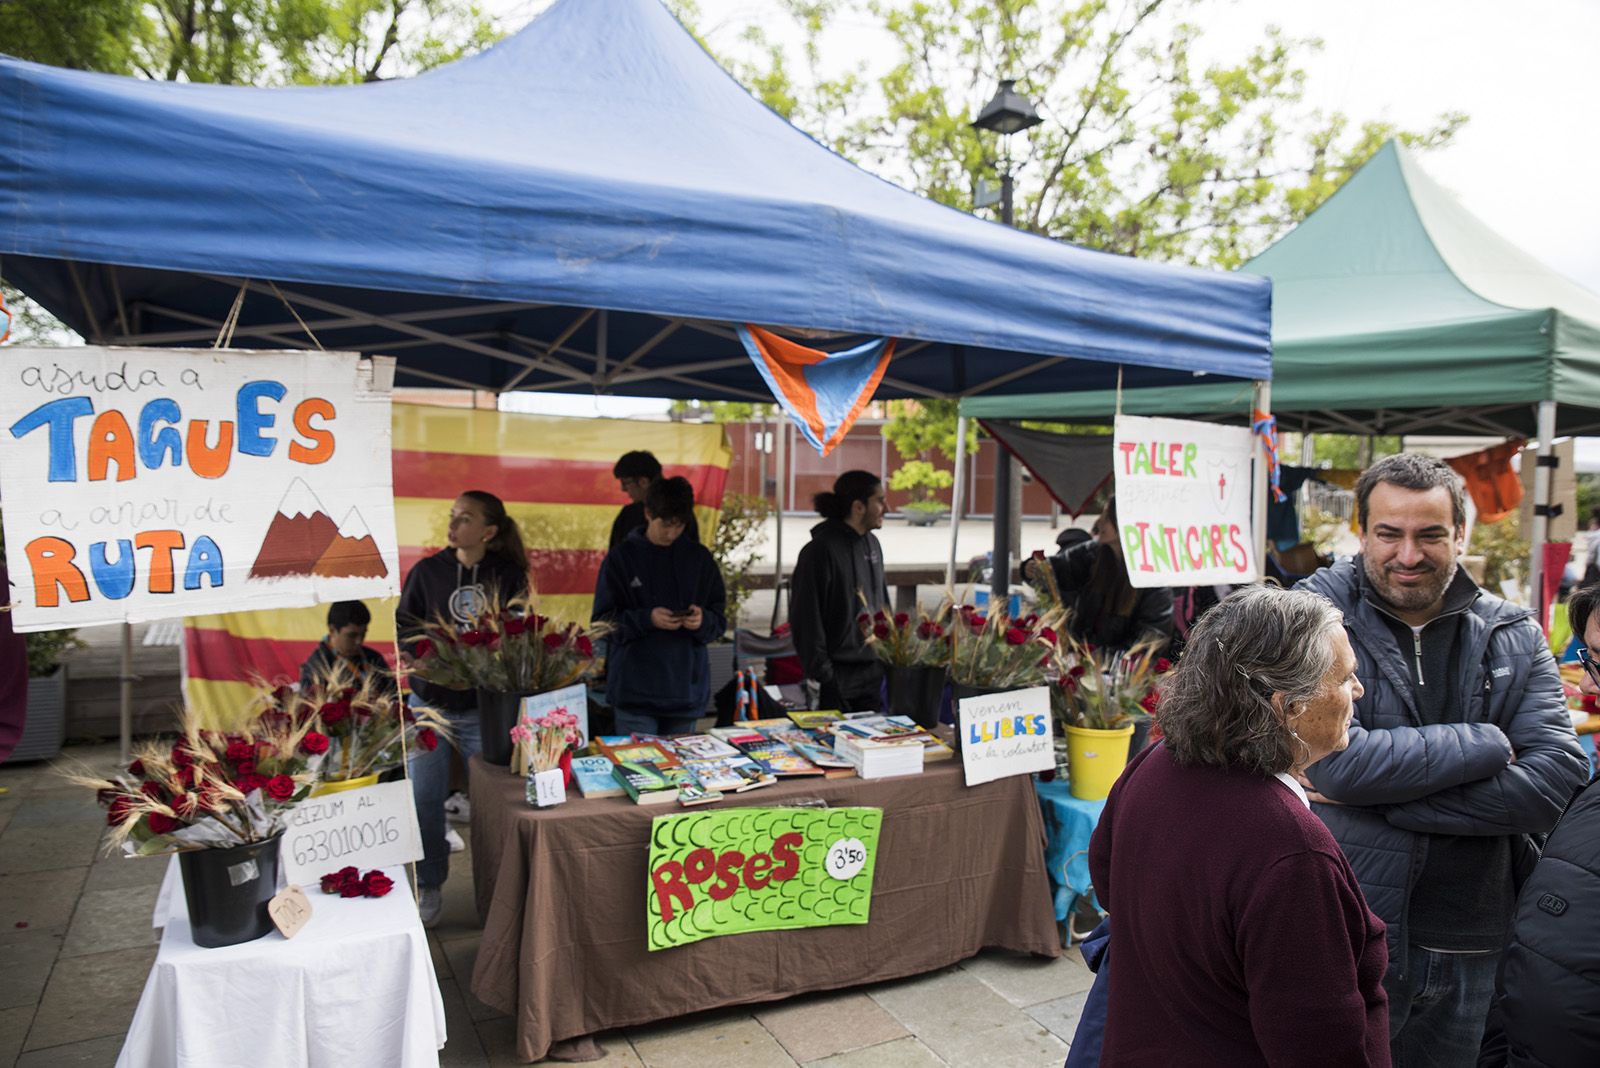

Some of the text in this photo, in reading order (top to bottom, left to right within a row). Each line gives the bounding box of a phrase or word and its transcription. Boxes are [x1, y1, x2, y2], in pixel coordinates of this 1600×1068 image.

[21, 362, 204, 395] ajuda a
[1119, 442, 1198, 478] TALLER
[40, 498, 235, 530] a anar de
[1123, 522, 1248, 573] PINTACARES
[24, 529, 224, 608] RUTA
[970, 713, 1047, 745] LLIBRES
[579, 759, 606, 767] 100
[292, 816, 400, 866] 633010016
[833, 847, 864, 869] 3'50
